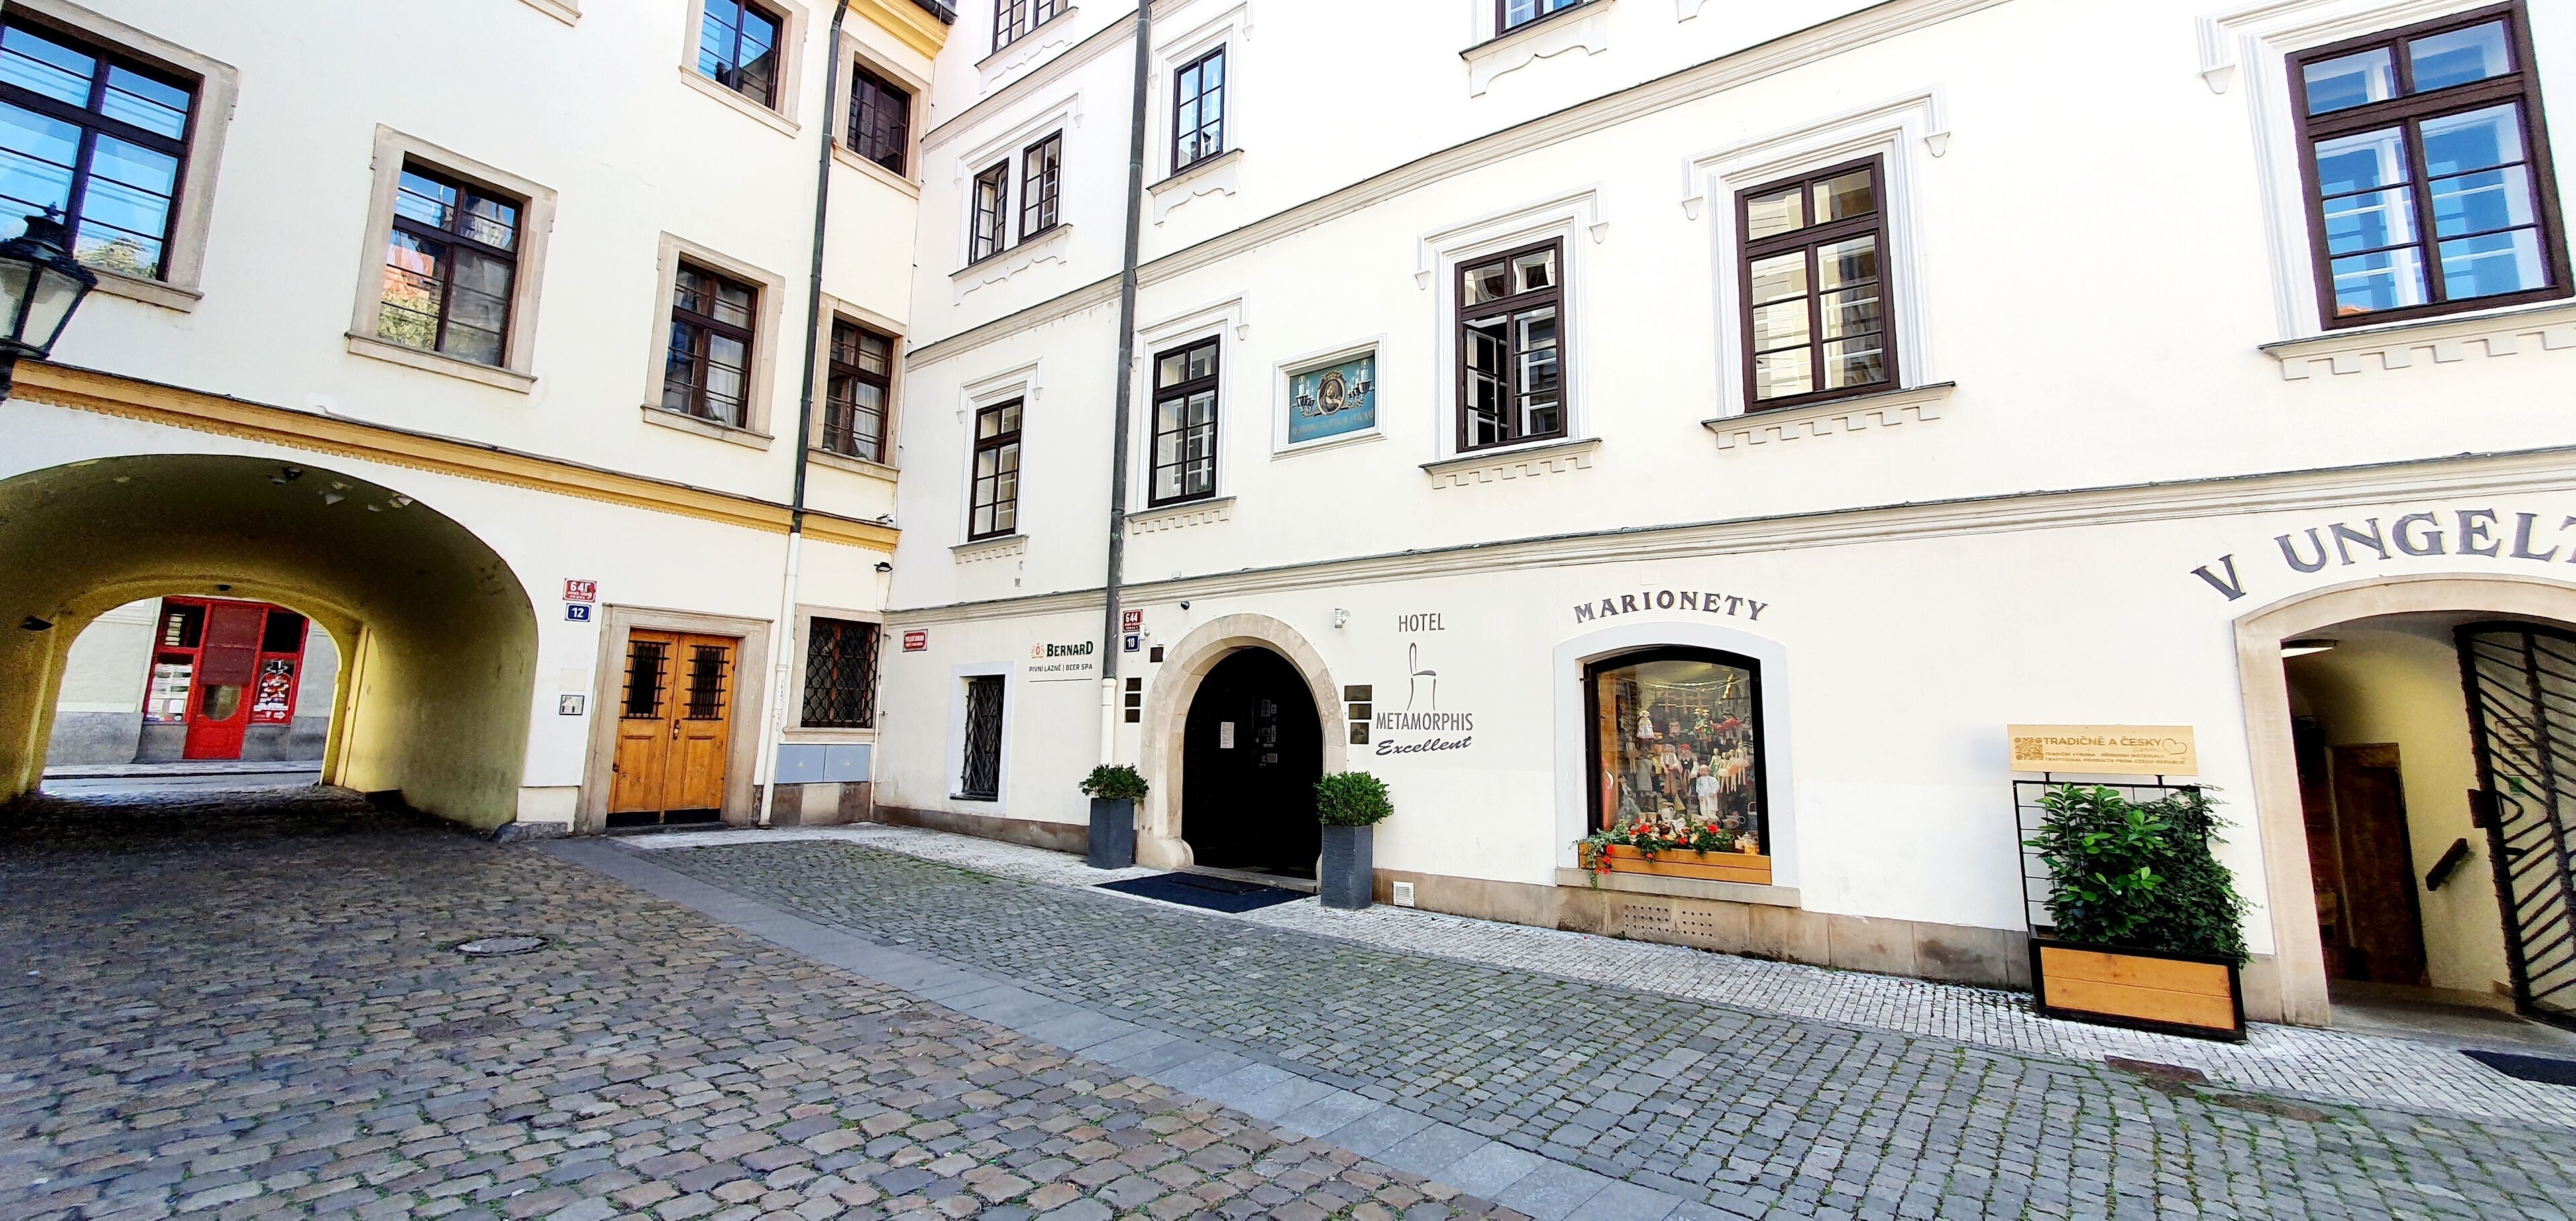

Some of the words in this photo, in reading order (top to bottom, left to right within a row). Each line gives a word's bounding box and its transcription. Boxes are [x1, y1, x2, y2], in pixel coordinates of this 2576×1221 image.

[2190, 553, 2247, 602] V
[572, 606, 584, 618] 12
[1573, 590, 1769, 624] MARIONETY
[1125, 612, 1138, 623] 644
[1398, 613, 1446, 632] HOTEL
[1046, 641, 1093, 657] BERNARD
[1127, 637, 1135, 648] 10
[1028, 664, 1043, 672] PIVNÍ
[1044, 663, 1061, 672] LÁZNĚ
[1376, 712, 1473, 731] METAMORPHIS
[1375, 736, 1473, 755] Excellent
[2121, 737, 2161, 746] ČESKY
